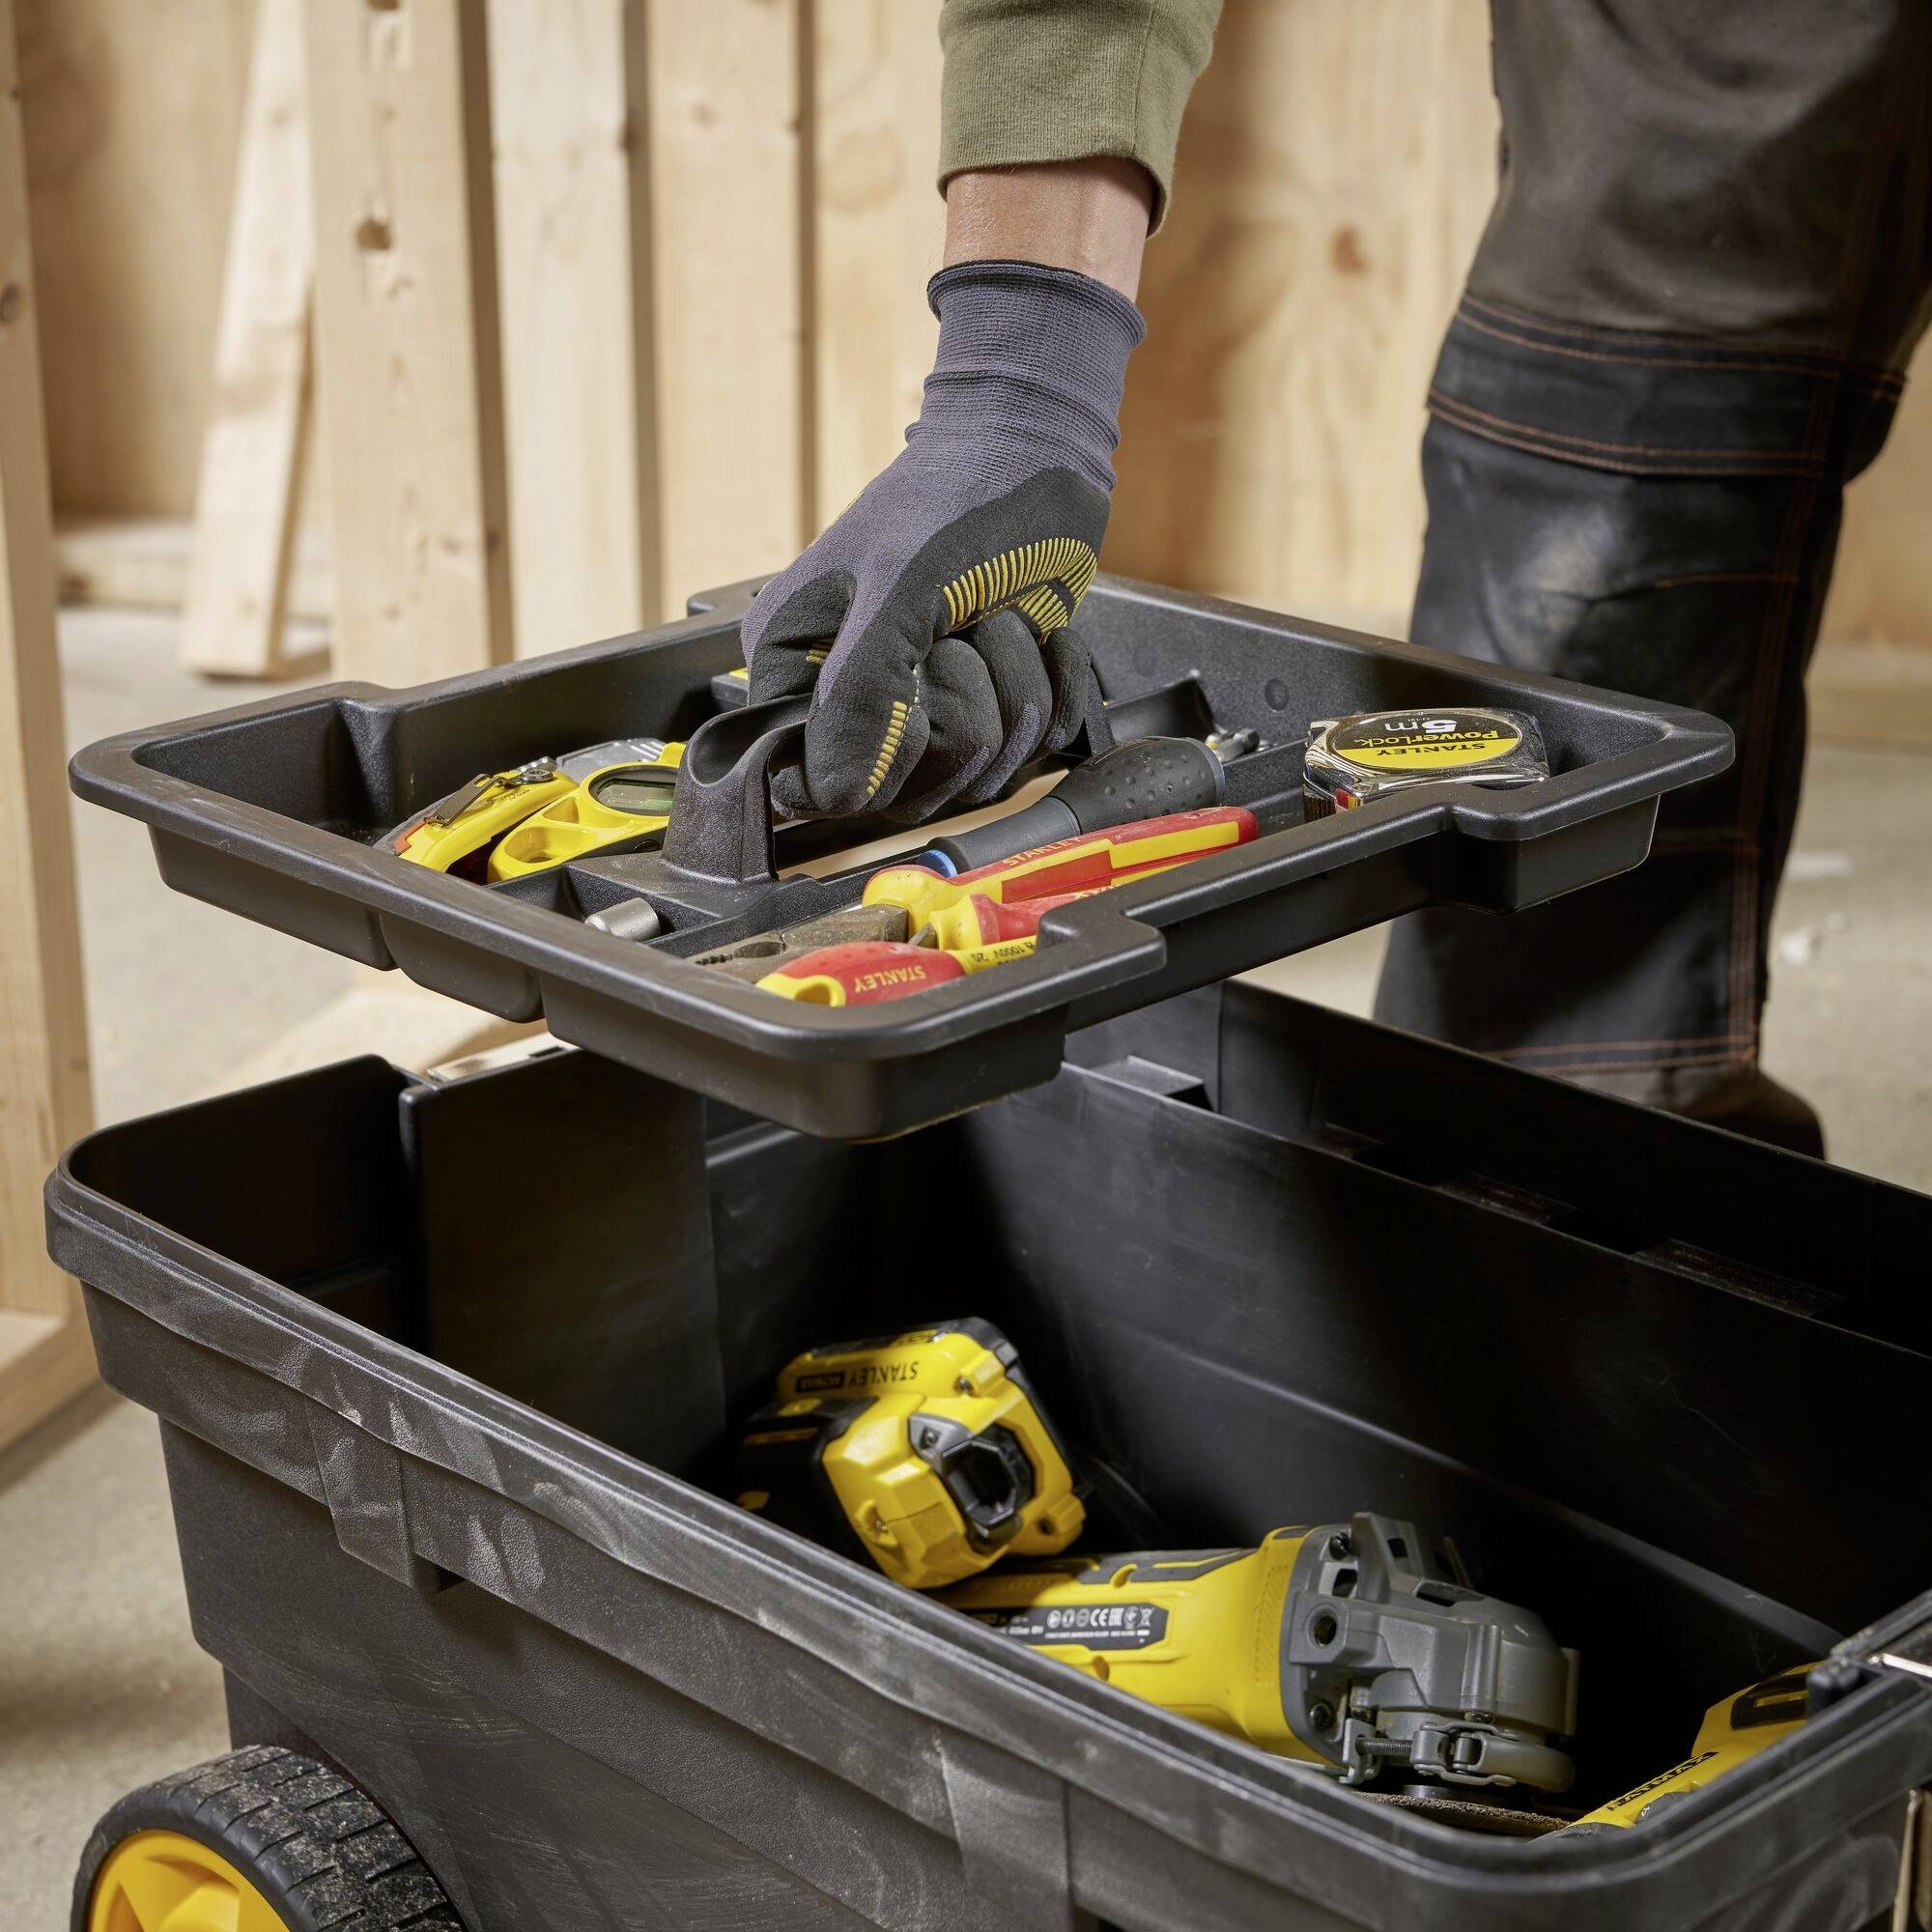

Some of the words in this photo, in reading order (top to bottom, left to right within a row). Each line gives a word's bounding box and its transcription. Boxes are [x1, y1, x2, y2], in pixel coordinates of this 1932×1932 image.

[1377, 743, 1486, 756] STANLEY
[1003, 836, 1082, 867] STANLEY
[854, 965, 926, 994] STANLEY
[847, 1361, 921, 1388] STANLEY
